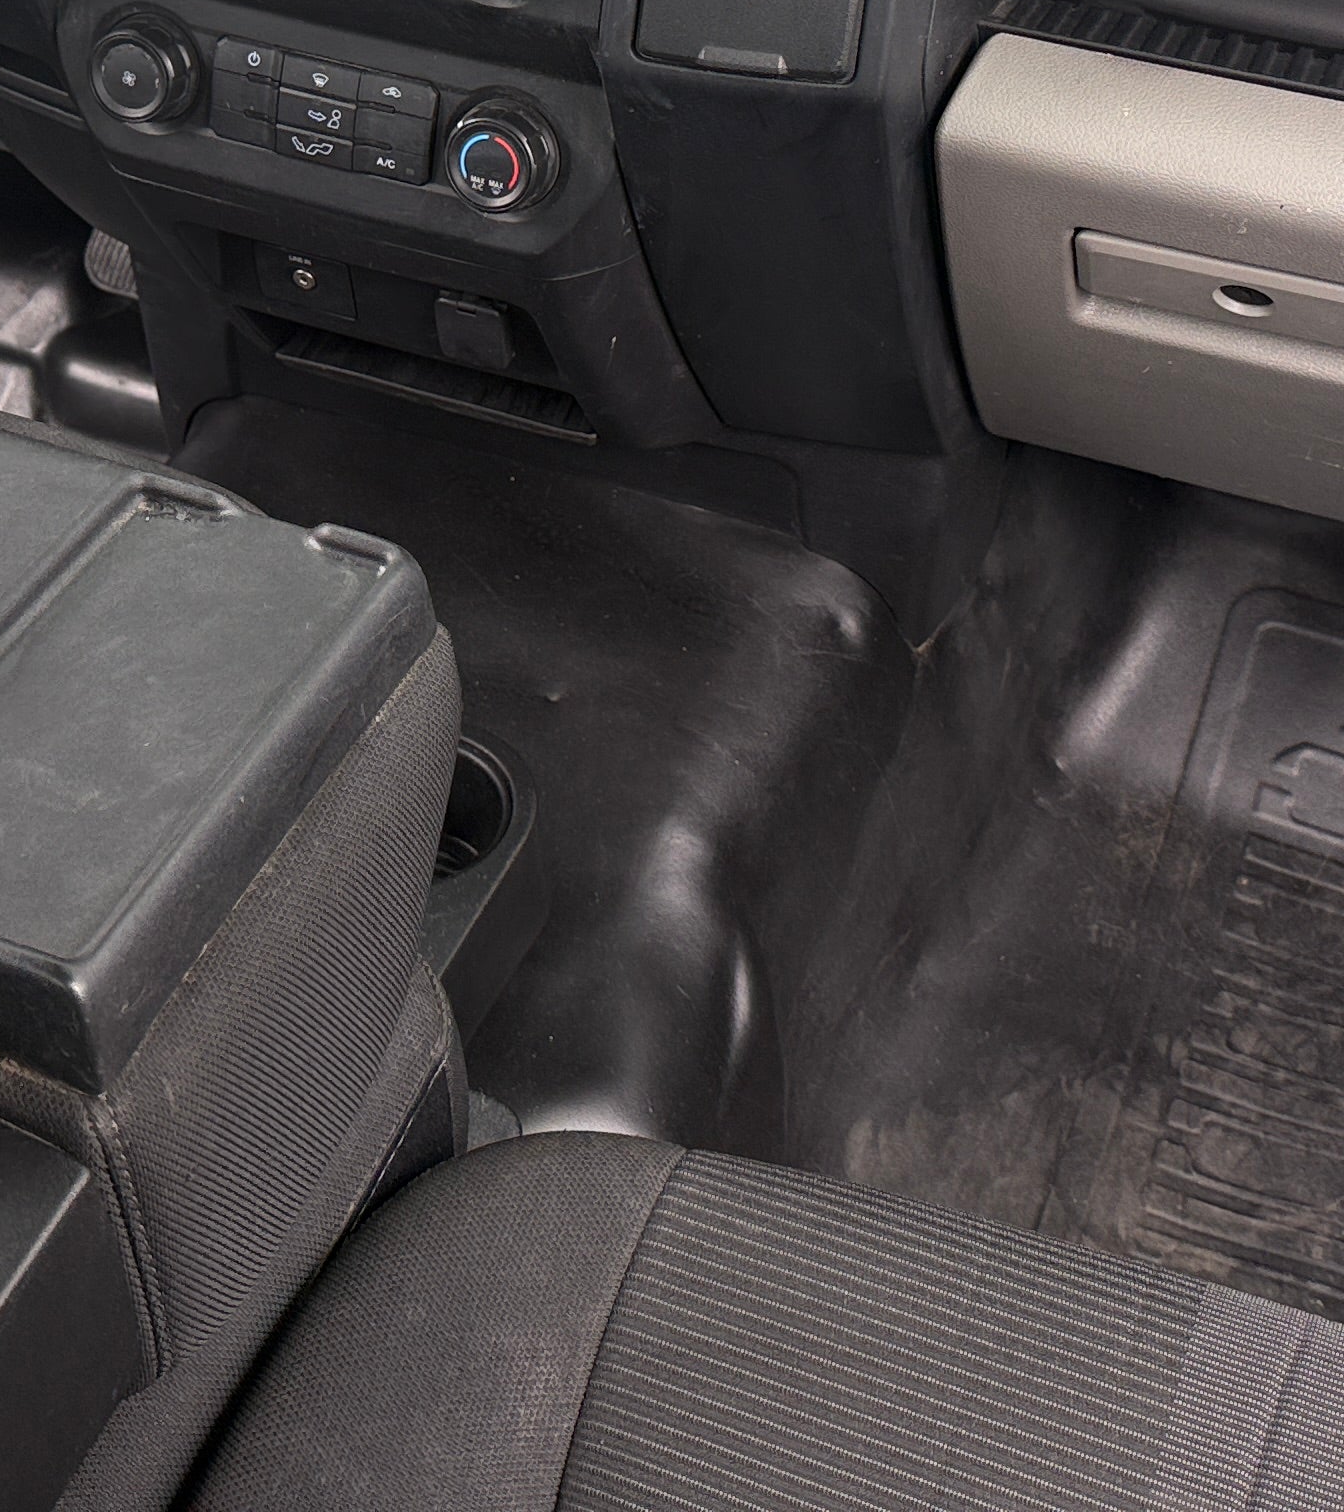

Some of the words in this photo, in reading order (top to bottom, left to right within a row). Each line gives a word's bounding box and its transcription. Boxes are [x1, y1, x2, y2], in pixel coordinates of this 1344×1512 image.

[376, 157, 396, 170] A/C
[470, 174, 485, 185] MAX
[488, 179, 504, 189] MAX
